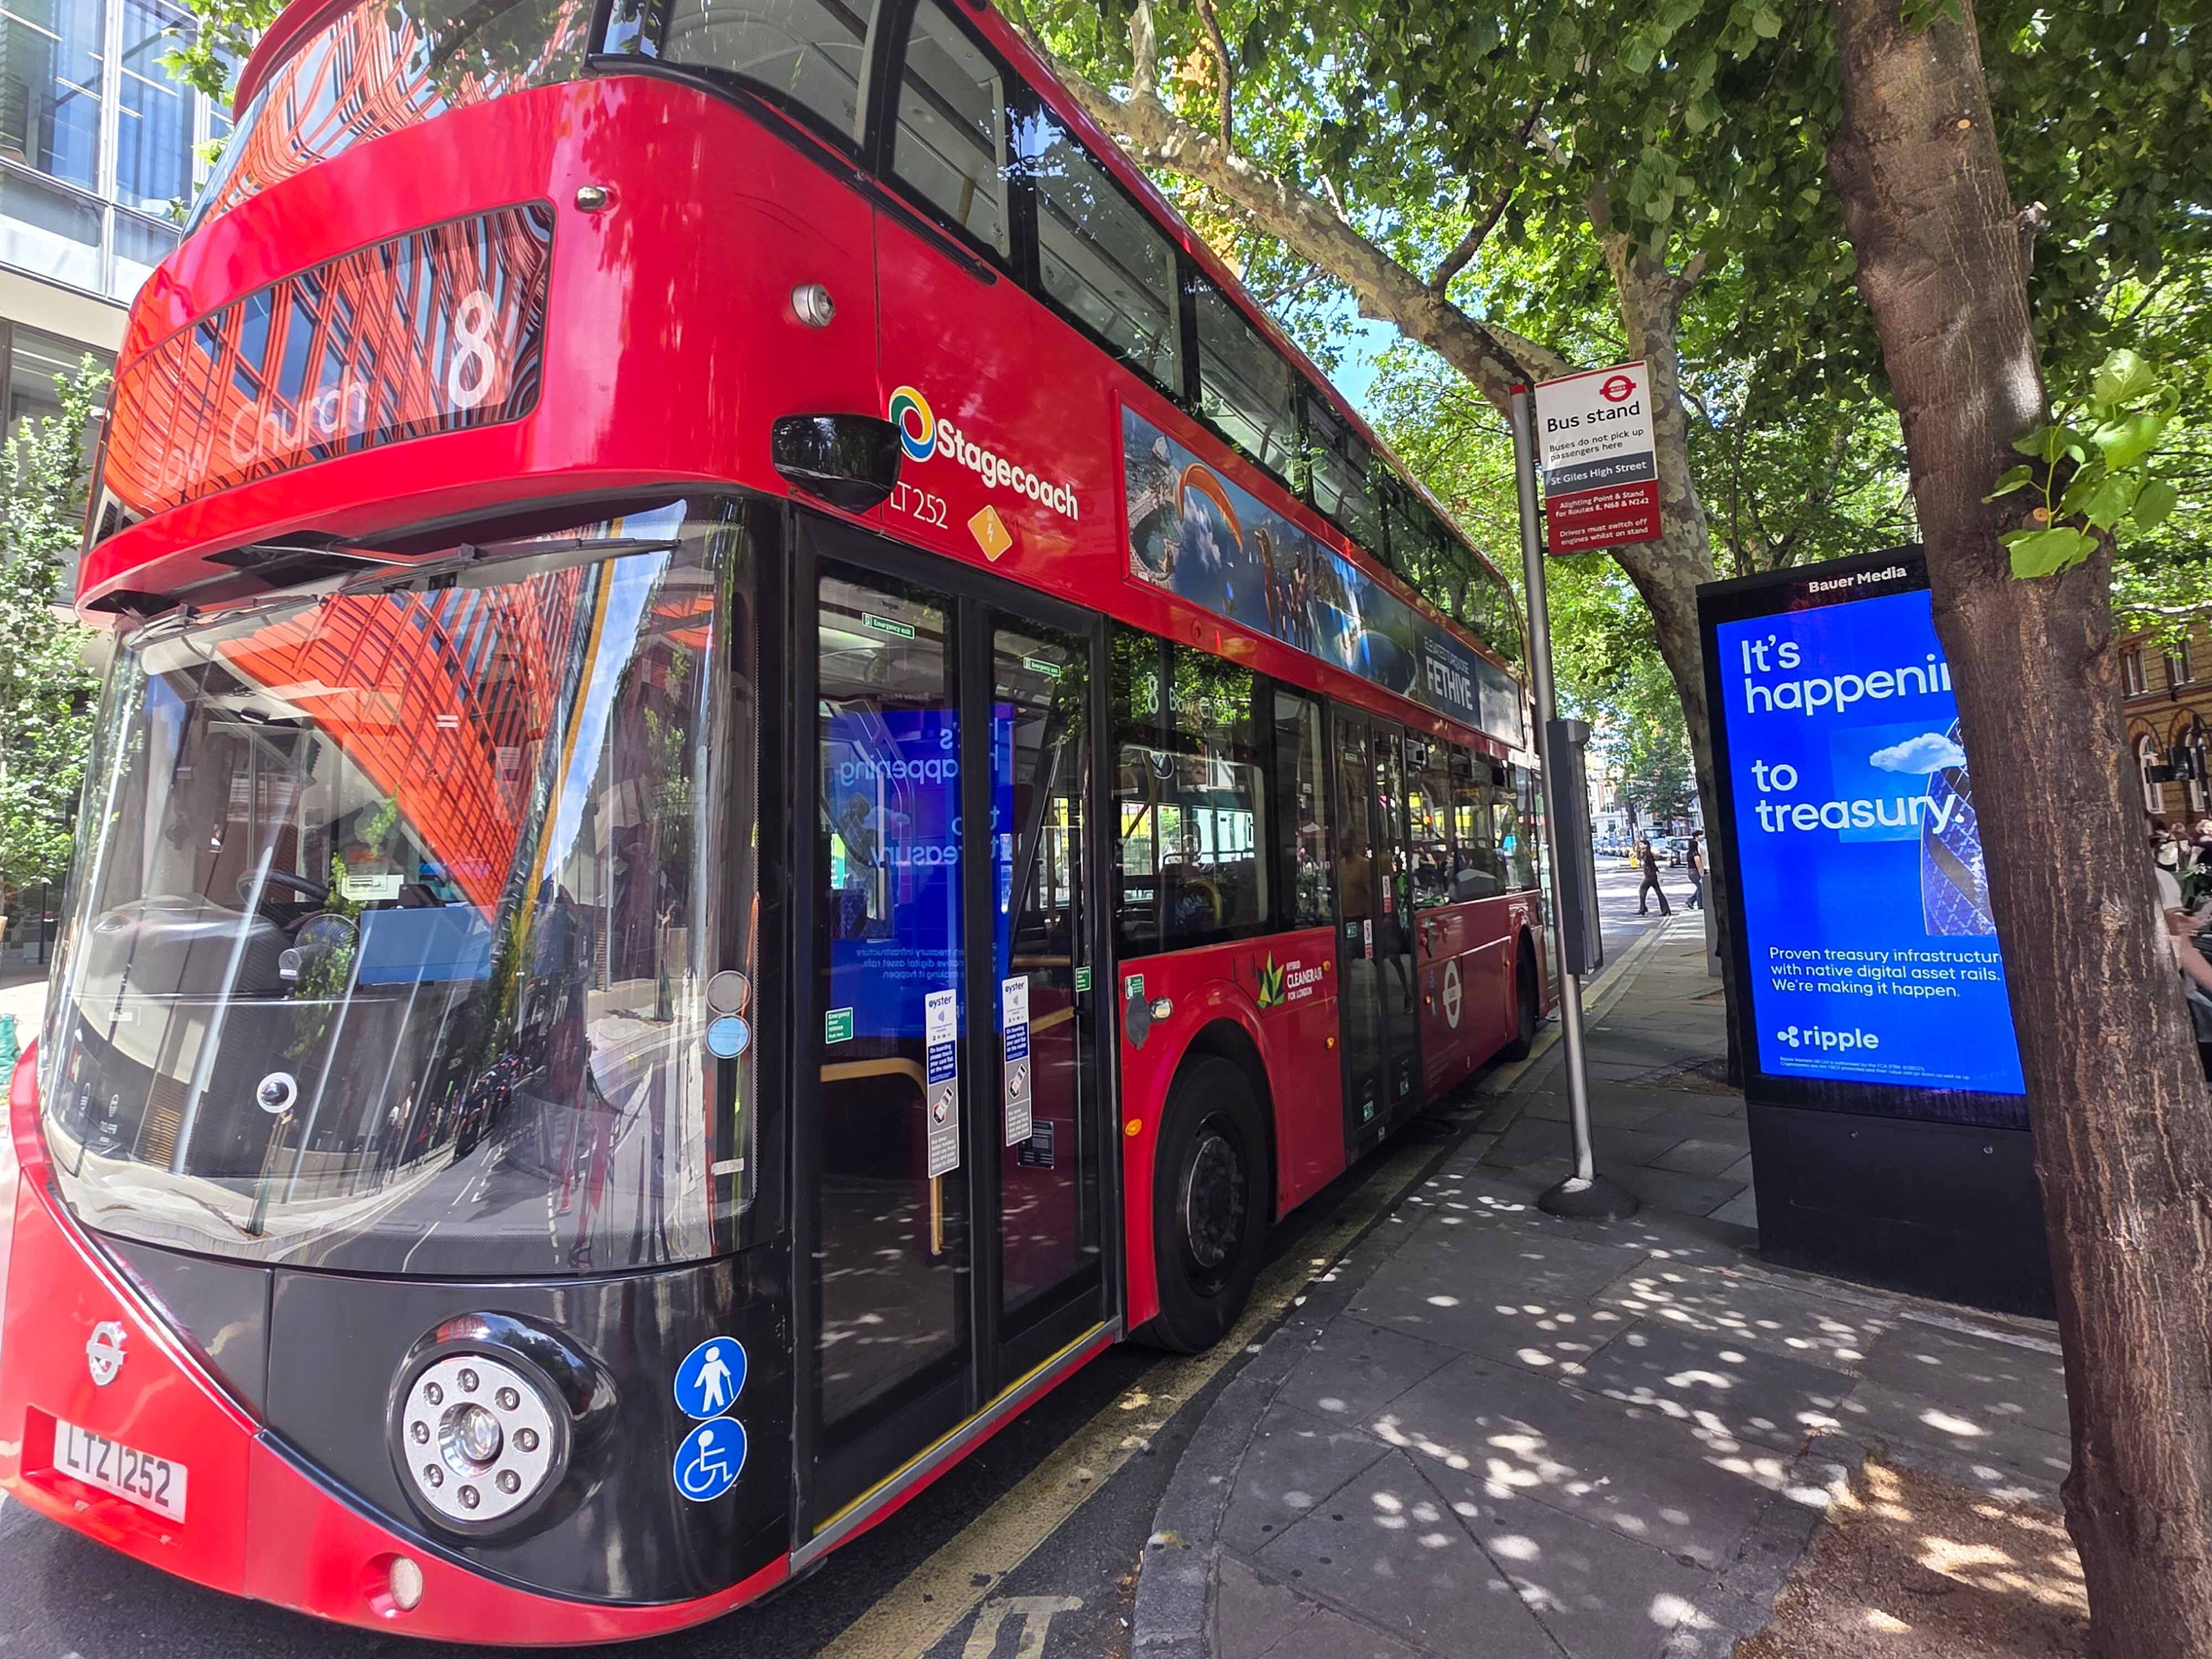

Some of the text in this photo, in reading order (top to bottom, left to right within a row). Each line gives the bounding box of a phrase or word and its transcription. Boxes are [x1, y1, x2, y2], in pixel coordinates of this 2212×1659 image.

[448, 290, 495, 408] 8
[230, 364, 370, 465] Church
[1547, 401, 1641, 433] Bus stand
[1550, 442, 1575, 452] Buses
[1578, 438, 1589, 446] do
[1592, 435, 1608, 444] not
[1611, 430, 1630, 441] pick
[1550, 441, 1623, 463] passengers here
[938, 419, 1079, 520] Stagecoach
[1563, 472, 1588, 482] Giles
[1590, 467, 1613, 478] High
[1615, 461, 1647, 473] Street
[890, 481, 948, 530] LT 252
[1559, 499, 1592, 509] Alighting
[1593, 494, 1614, 503] Point
[1623, 489, 1644, 498] Stand
[1568, 507, 1594, 516] Routes
[1604, 501, 1620, 509] N68
[1629, 498, 1649, 507] N242
[1559, 528, 1585, 538] Drivers
[1608, 520, 1633, 530] switch
[1635, 518, 1648, 526] off
[1561, 536, 1589, 545] engines
[1591, 531, 1614, 541] whilst
[1627, 527, 1648, 535] stand
[1809, 566, 1907, 594] Bauer Media
[1741, 634, 1801, 675] It's
[1147, 675, 1159, 714] 8
[1751, 759, 1798, 793] to
[1755, 794, 1965, 834] treasury.
[1770, 947, 2002, 963] Proven treasury infrastructur
[1771, 963, 2001, 981] with native digital asset rails.
[1005, 982, 1025, 995] oyster
[1772, 978, 1960, 999] We're making it happen.
[928, 995, 952, 1009] oyster
[1803, 1026, 1879, 1051] ripple
